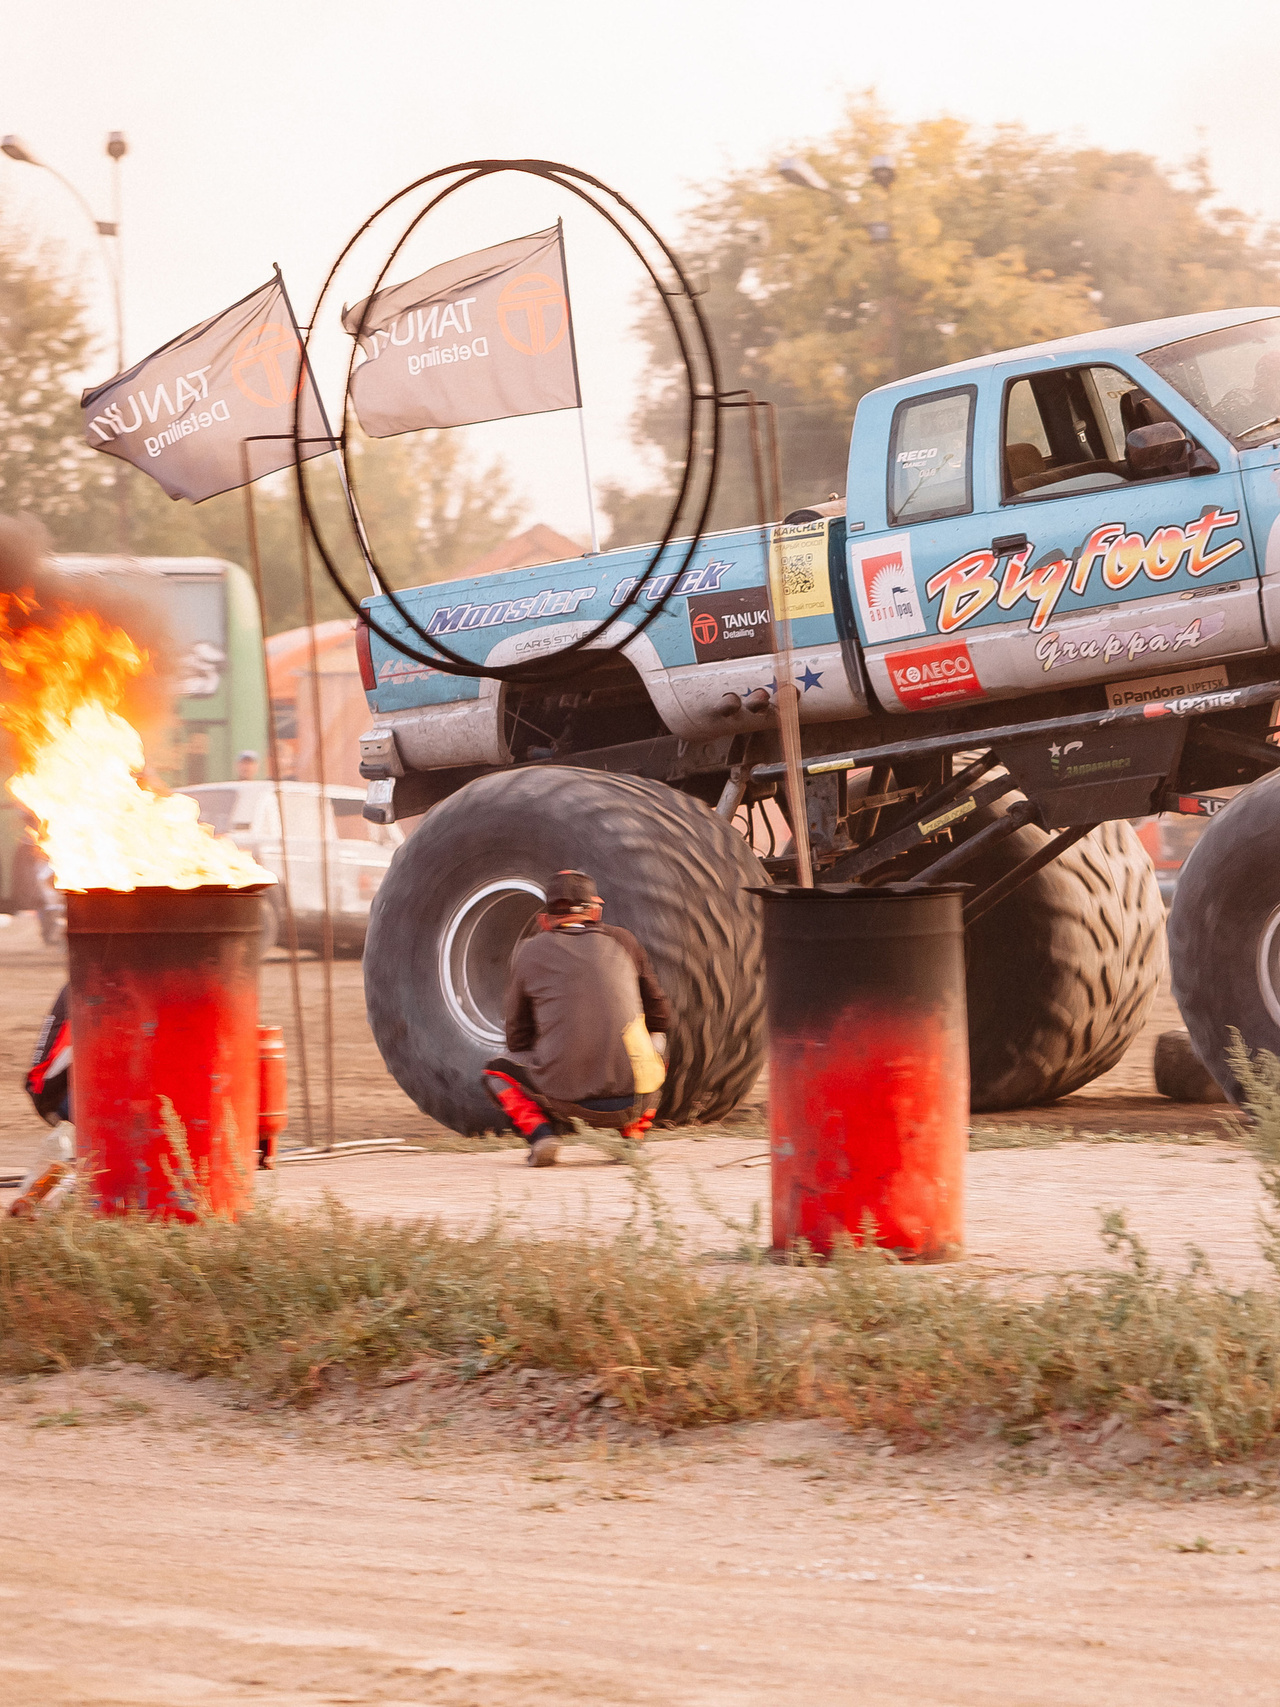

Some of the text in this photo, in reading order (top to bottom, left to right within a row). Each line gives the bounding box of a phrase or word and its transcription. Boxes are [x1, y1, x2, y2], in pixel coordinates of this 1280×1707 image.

[425, 586, 598, 637] Monster
[721, 609, 771, 629] TANUKI
[722, 628, 755, 640] Detailing
[1036, 630, 1169, 671] Gruppa
[892, 656, 971, 686] КОЛЕСО
[1123, 683, 1185, 704] Pandora
[1187, 678, 1225, 694] LIPETSK
